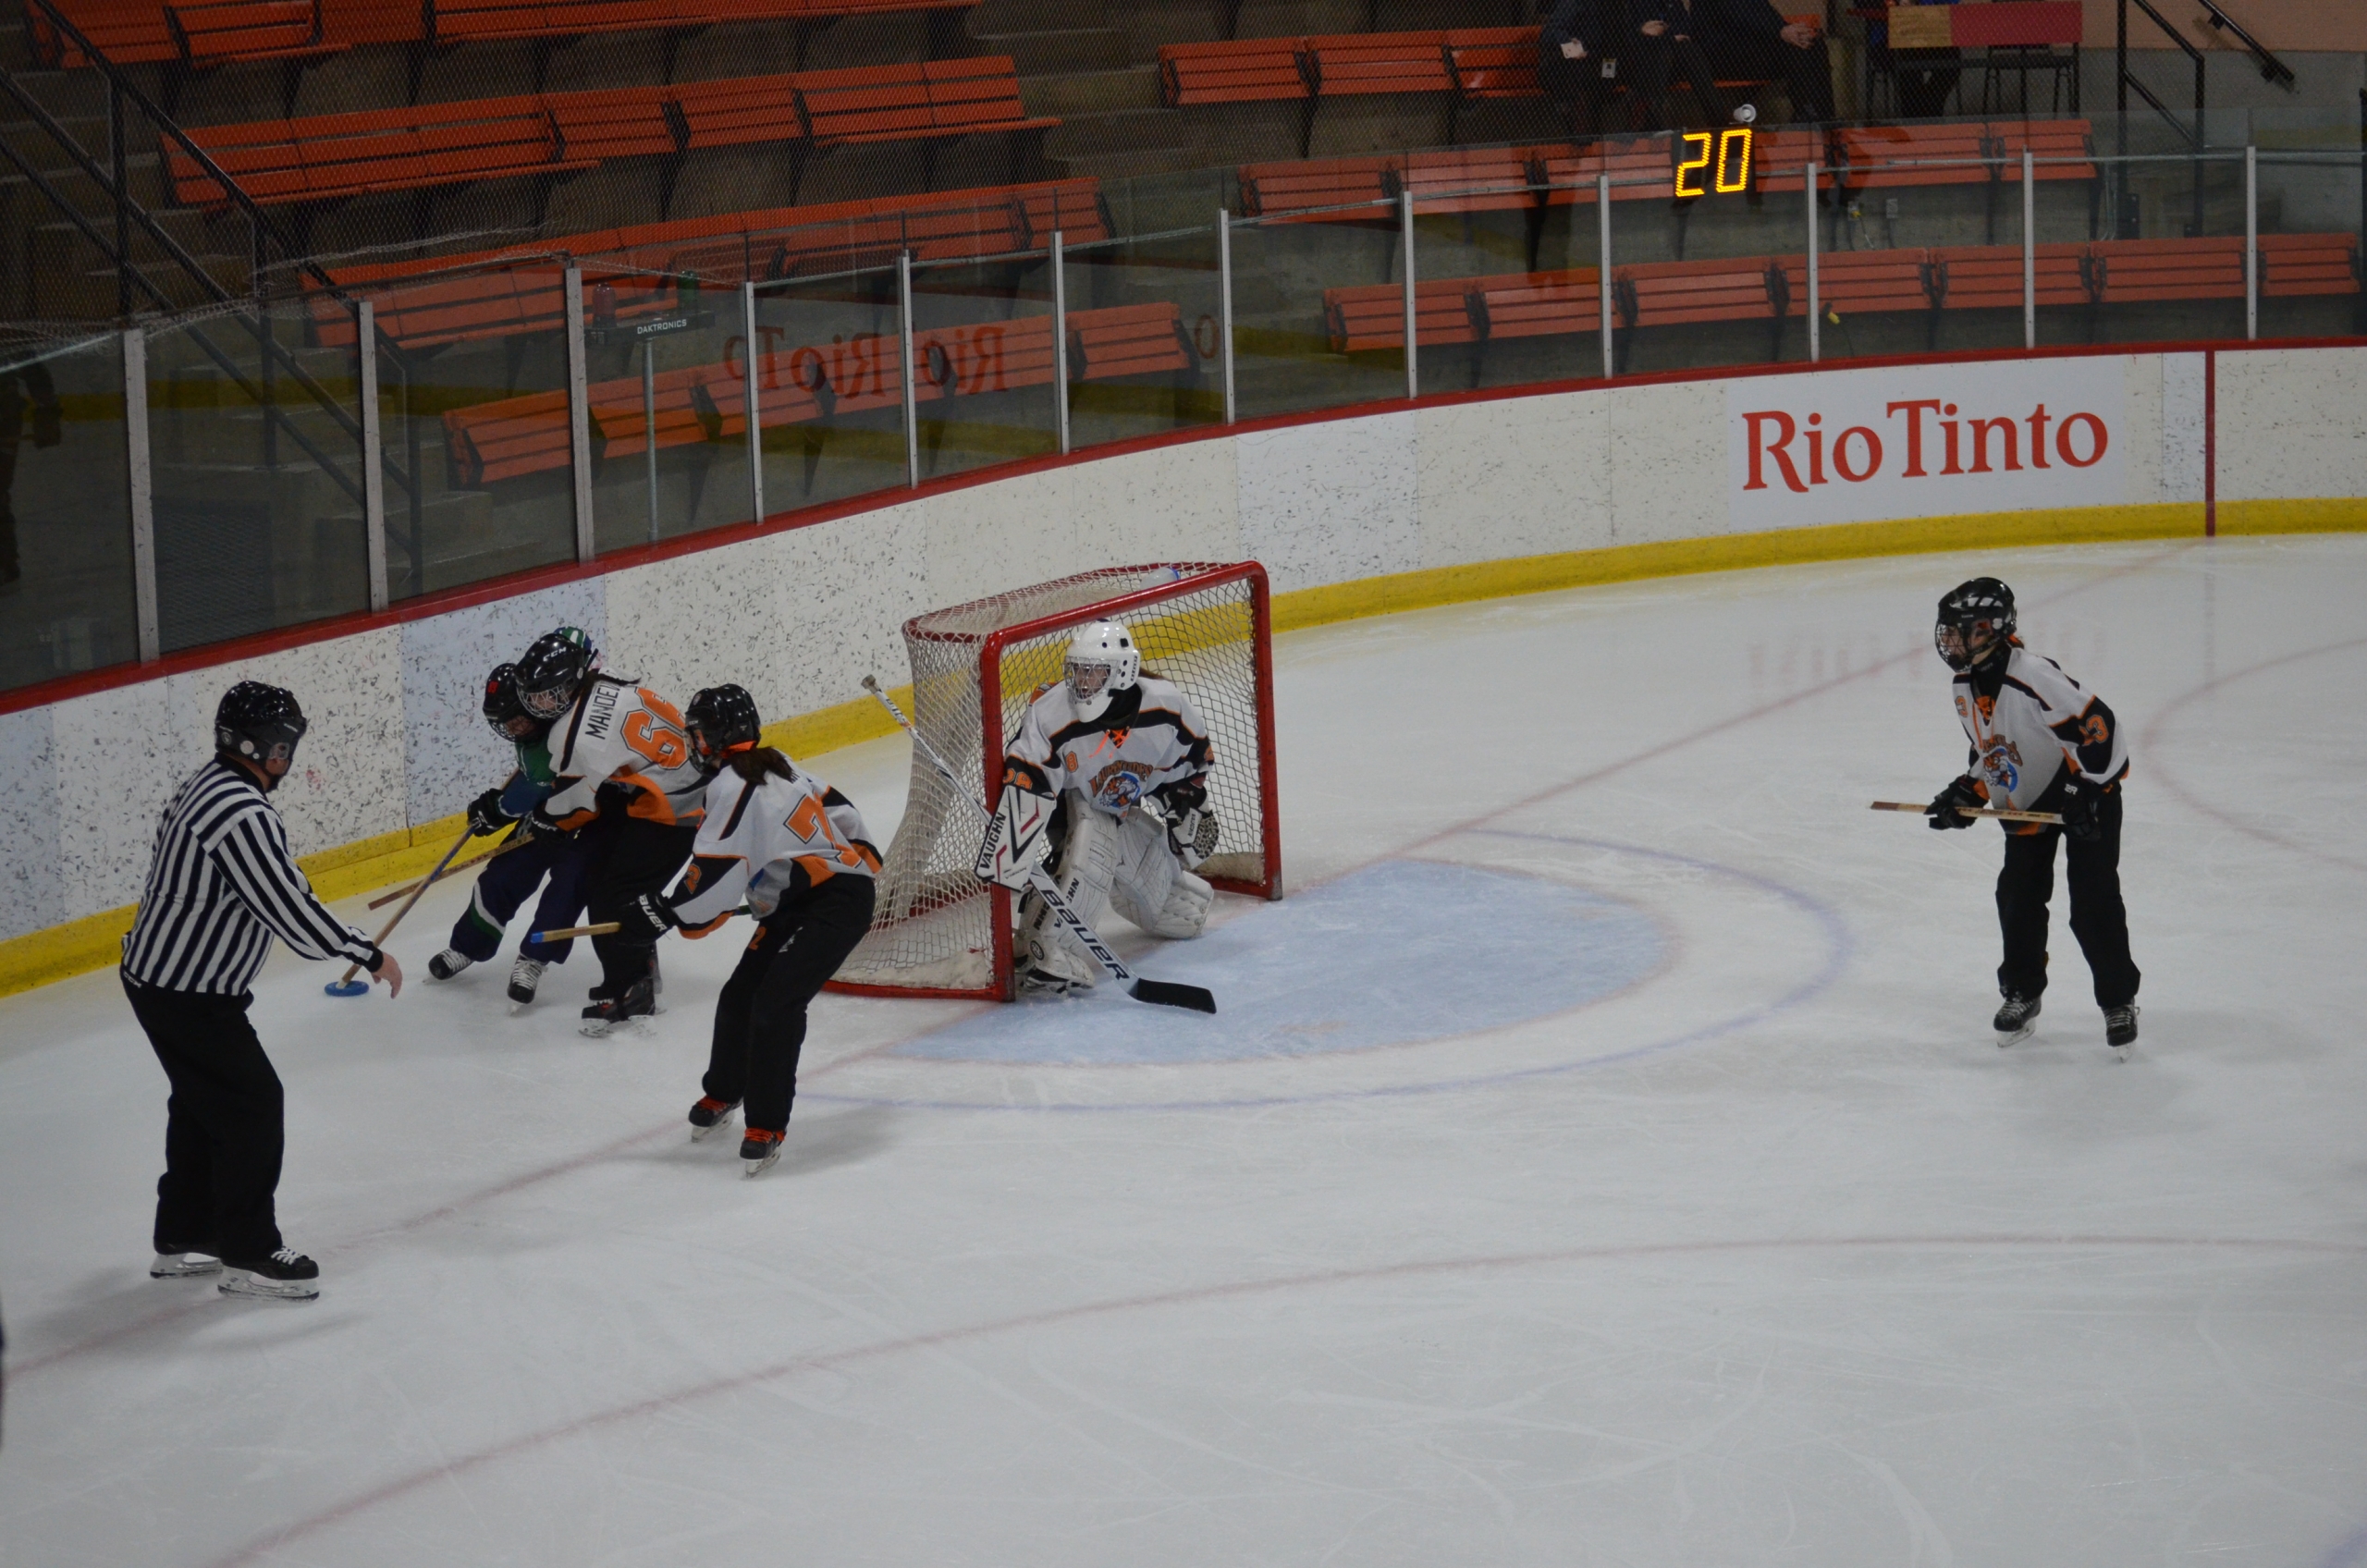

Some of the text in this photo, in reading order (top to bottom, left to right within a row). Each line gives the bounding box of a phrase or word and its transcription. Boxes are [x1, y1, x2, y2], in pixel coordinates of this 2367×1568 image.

[1675, 129, 1752, 197] 20
[637, 319, 687, 334] DAKTRONICS
[979, 812, 1007, 869] VAUGHN
[639, 894, 668, 933] AUER
[1040, 889, 1130, 980] BAUER
